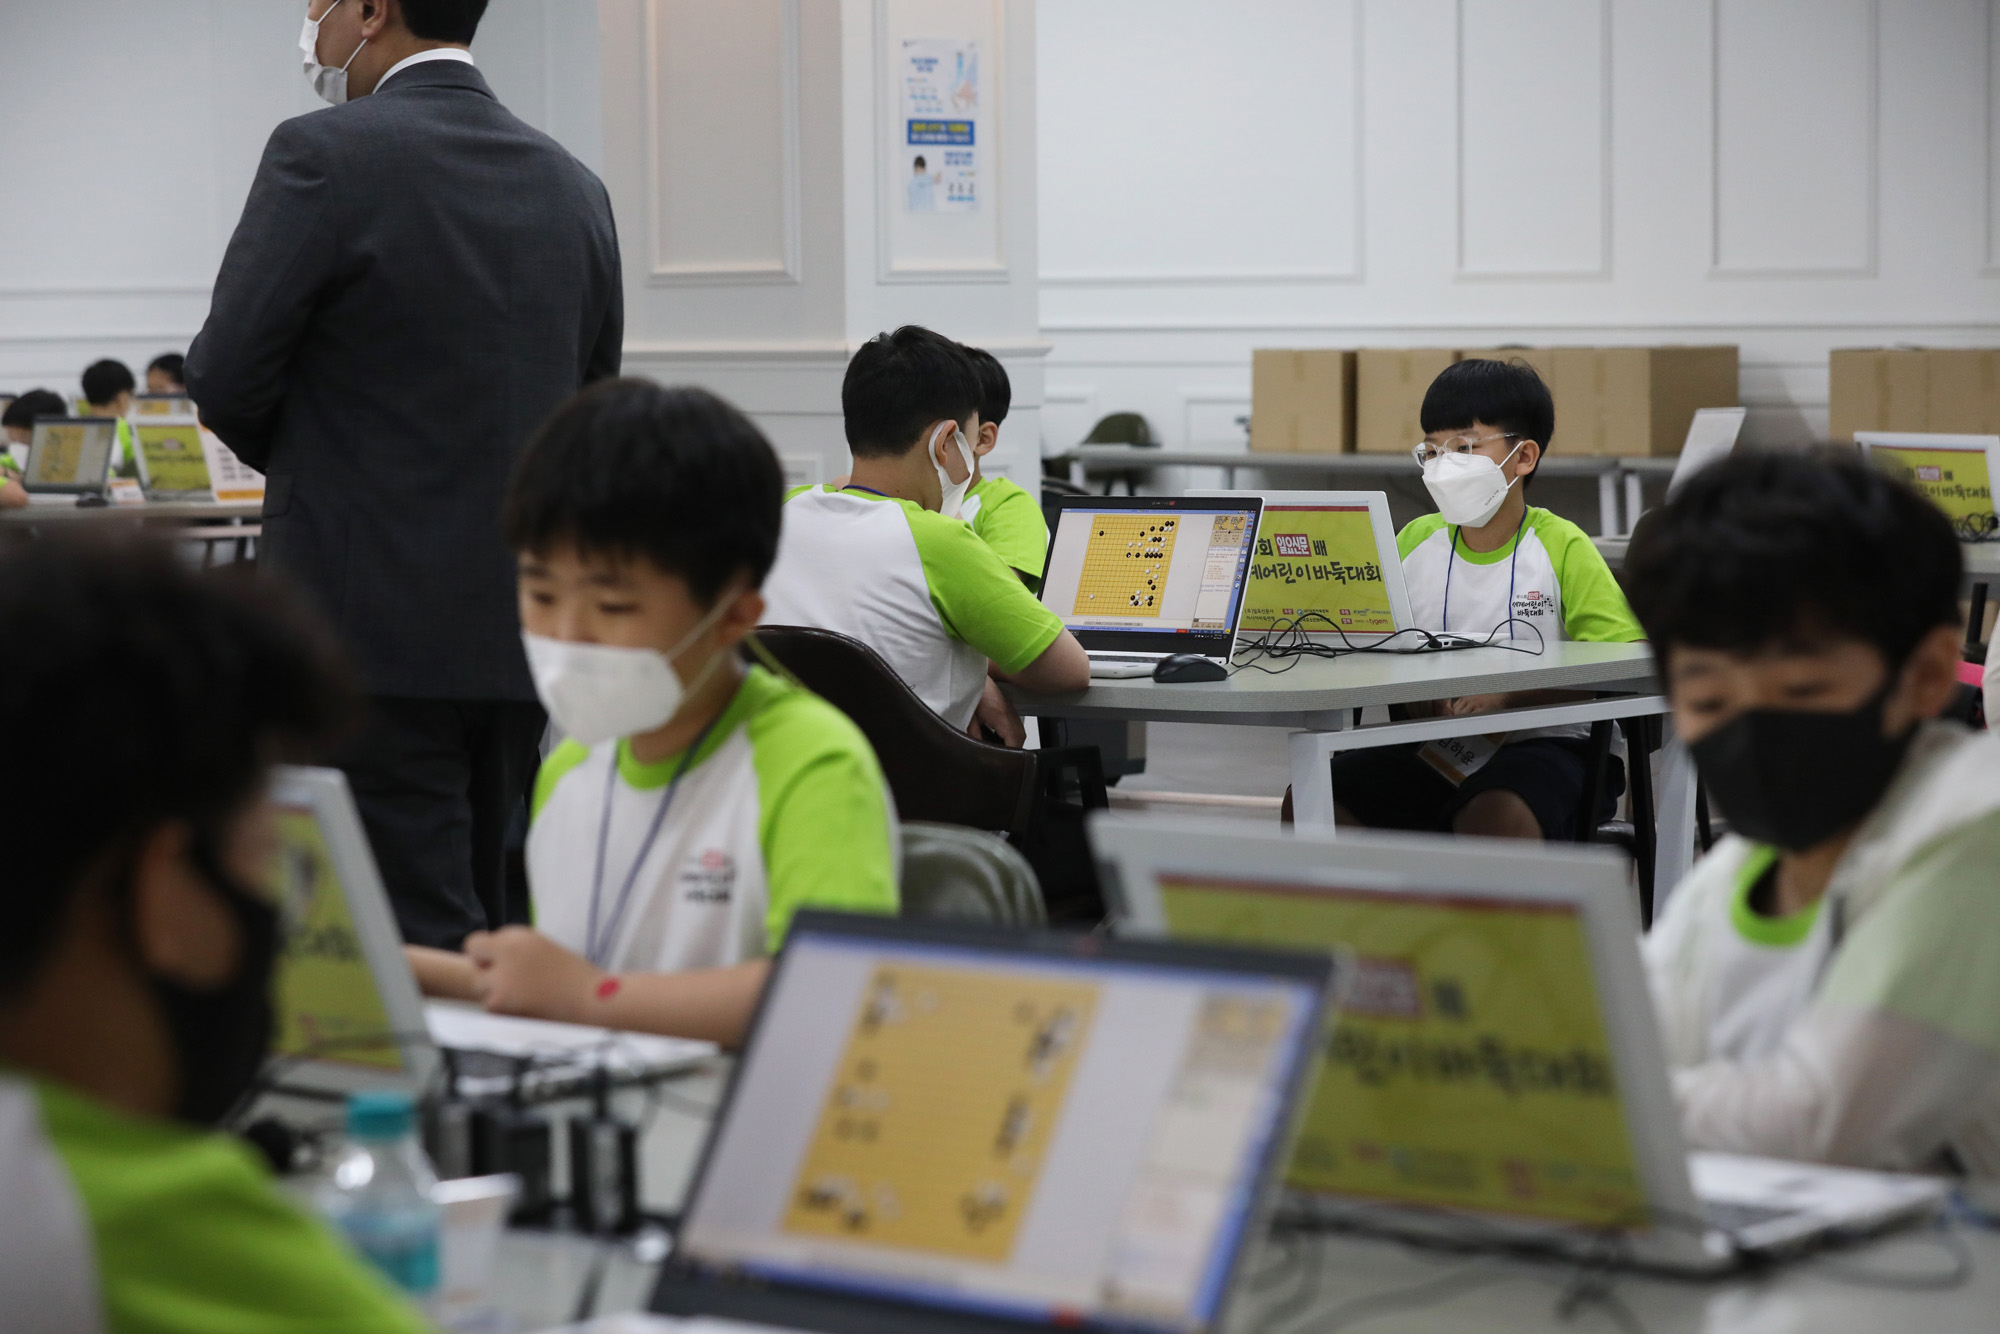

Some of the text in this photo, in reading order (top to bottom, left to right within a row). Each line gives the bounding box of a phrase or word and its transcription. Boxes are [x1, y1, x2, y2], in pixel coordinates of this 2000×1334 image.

[1254, 535, 1328, 557] 회 일요신문 배
[1368, 617, 1389, 625] tygem
